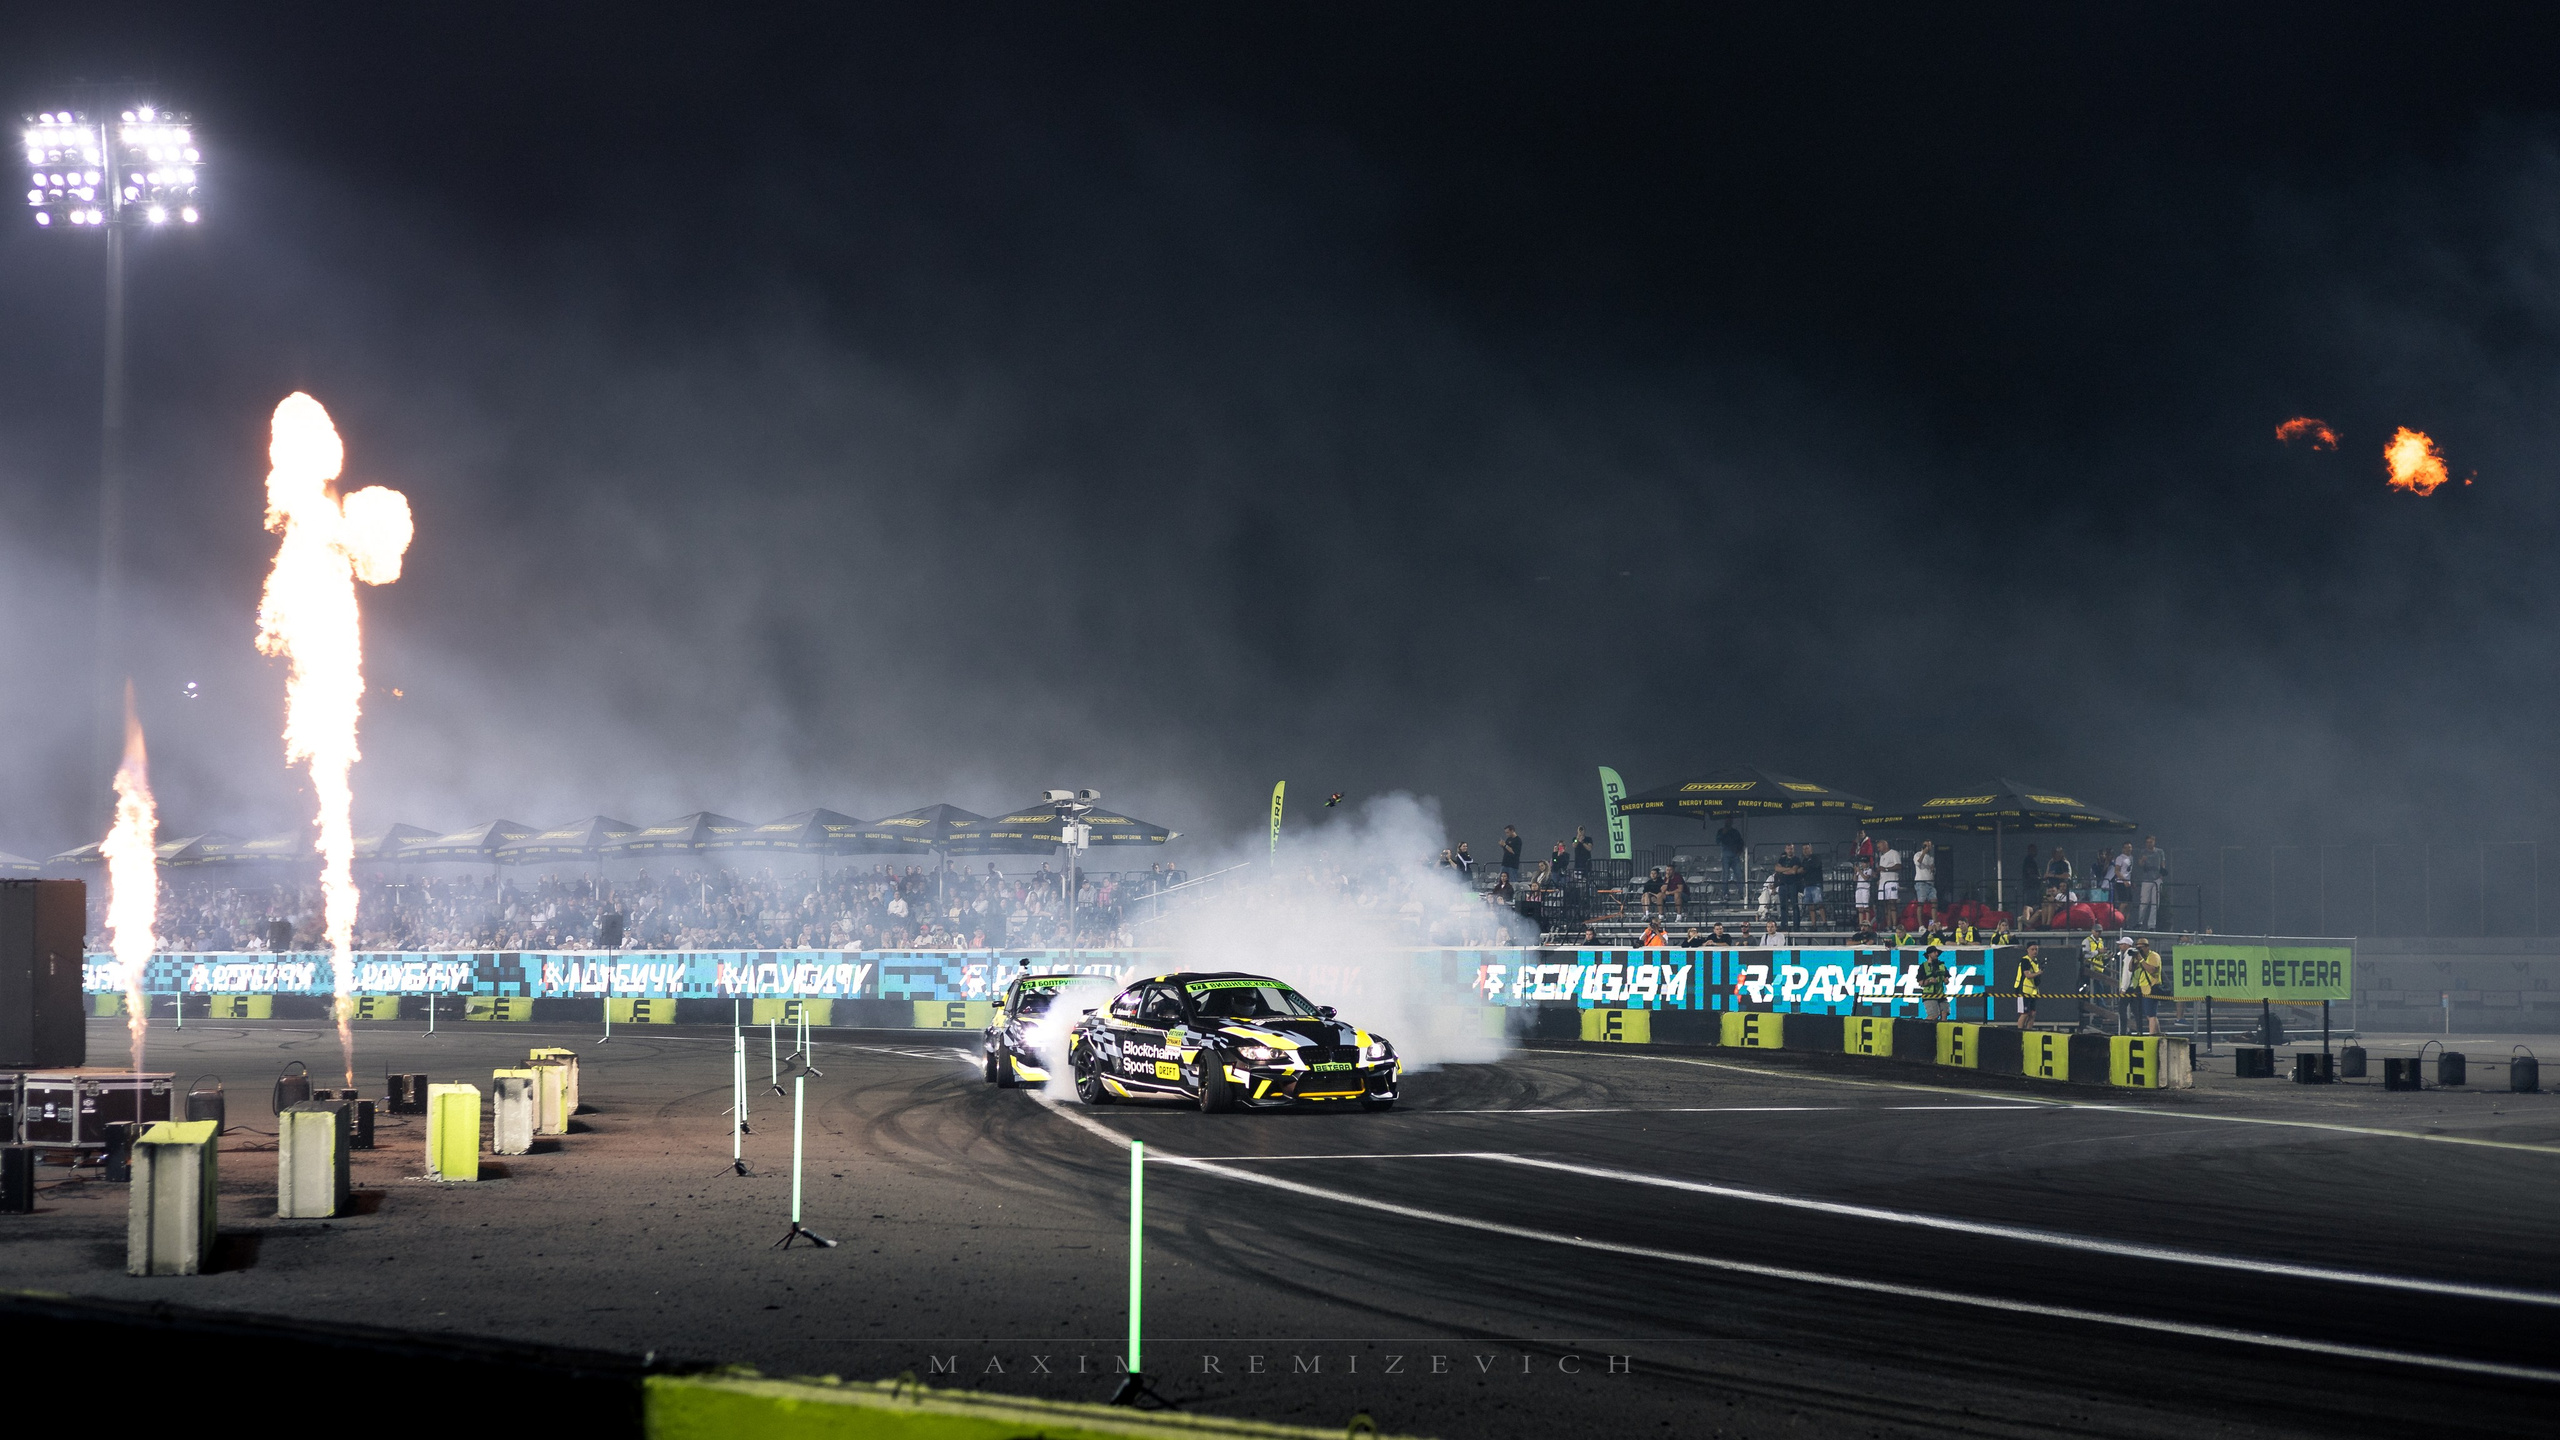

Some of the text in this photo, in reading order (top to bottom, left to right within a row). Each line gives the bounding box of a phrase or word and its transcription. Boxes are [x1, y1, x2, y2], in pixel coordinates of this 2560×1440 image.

[1621, 803, 1643, 811] ENERGY
[1763, 801, 1783, 809] DRINK
[2182, 959, 2342, 987] BETERA BETERA
[1123, 1040, 1174, 1060] Blockchain
[1123, 1056, 1176, 1077] Sports DRIFT
[1315, 1064, 1351, 1072] BETERA
